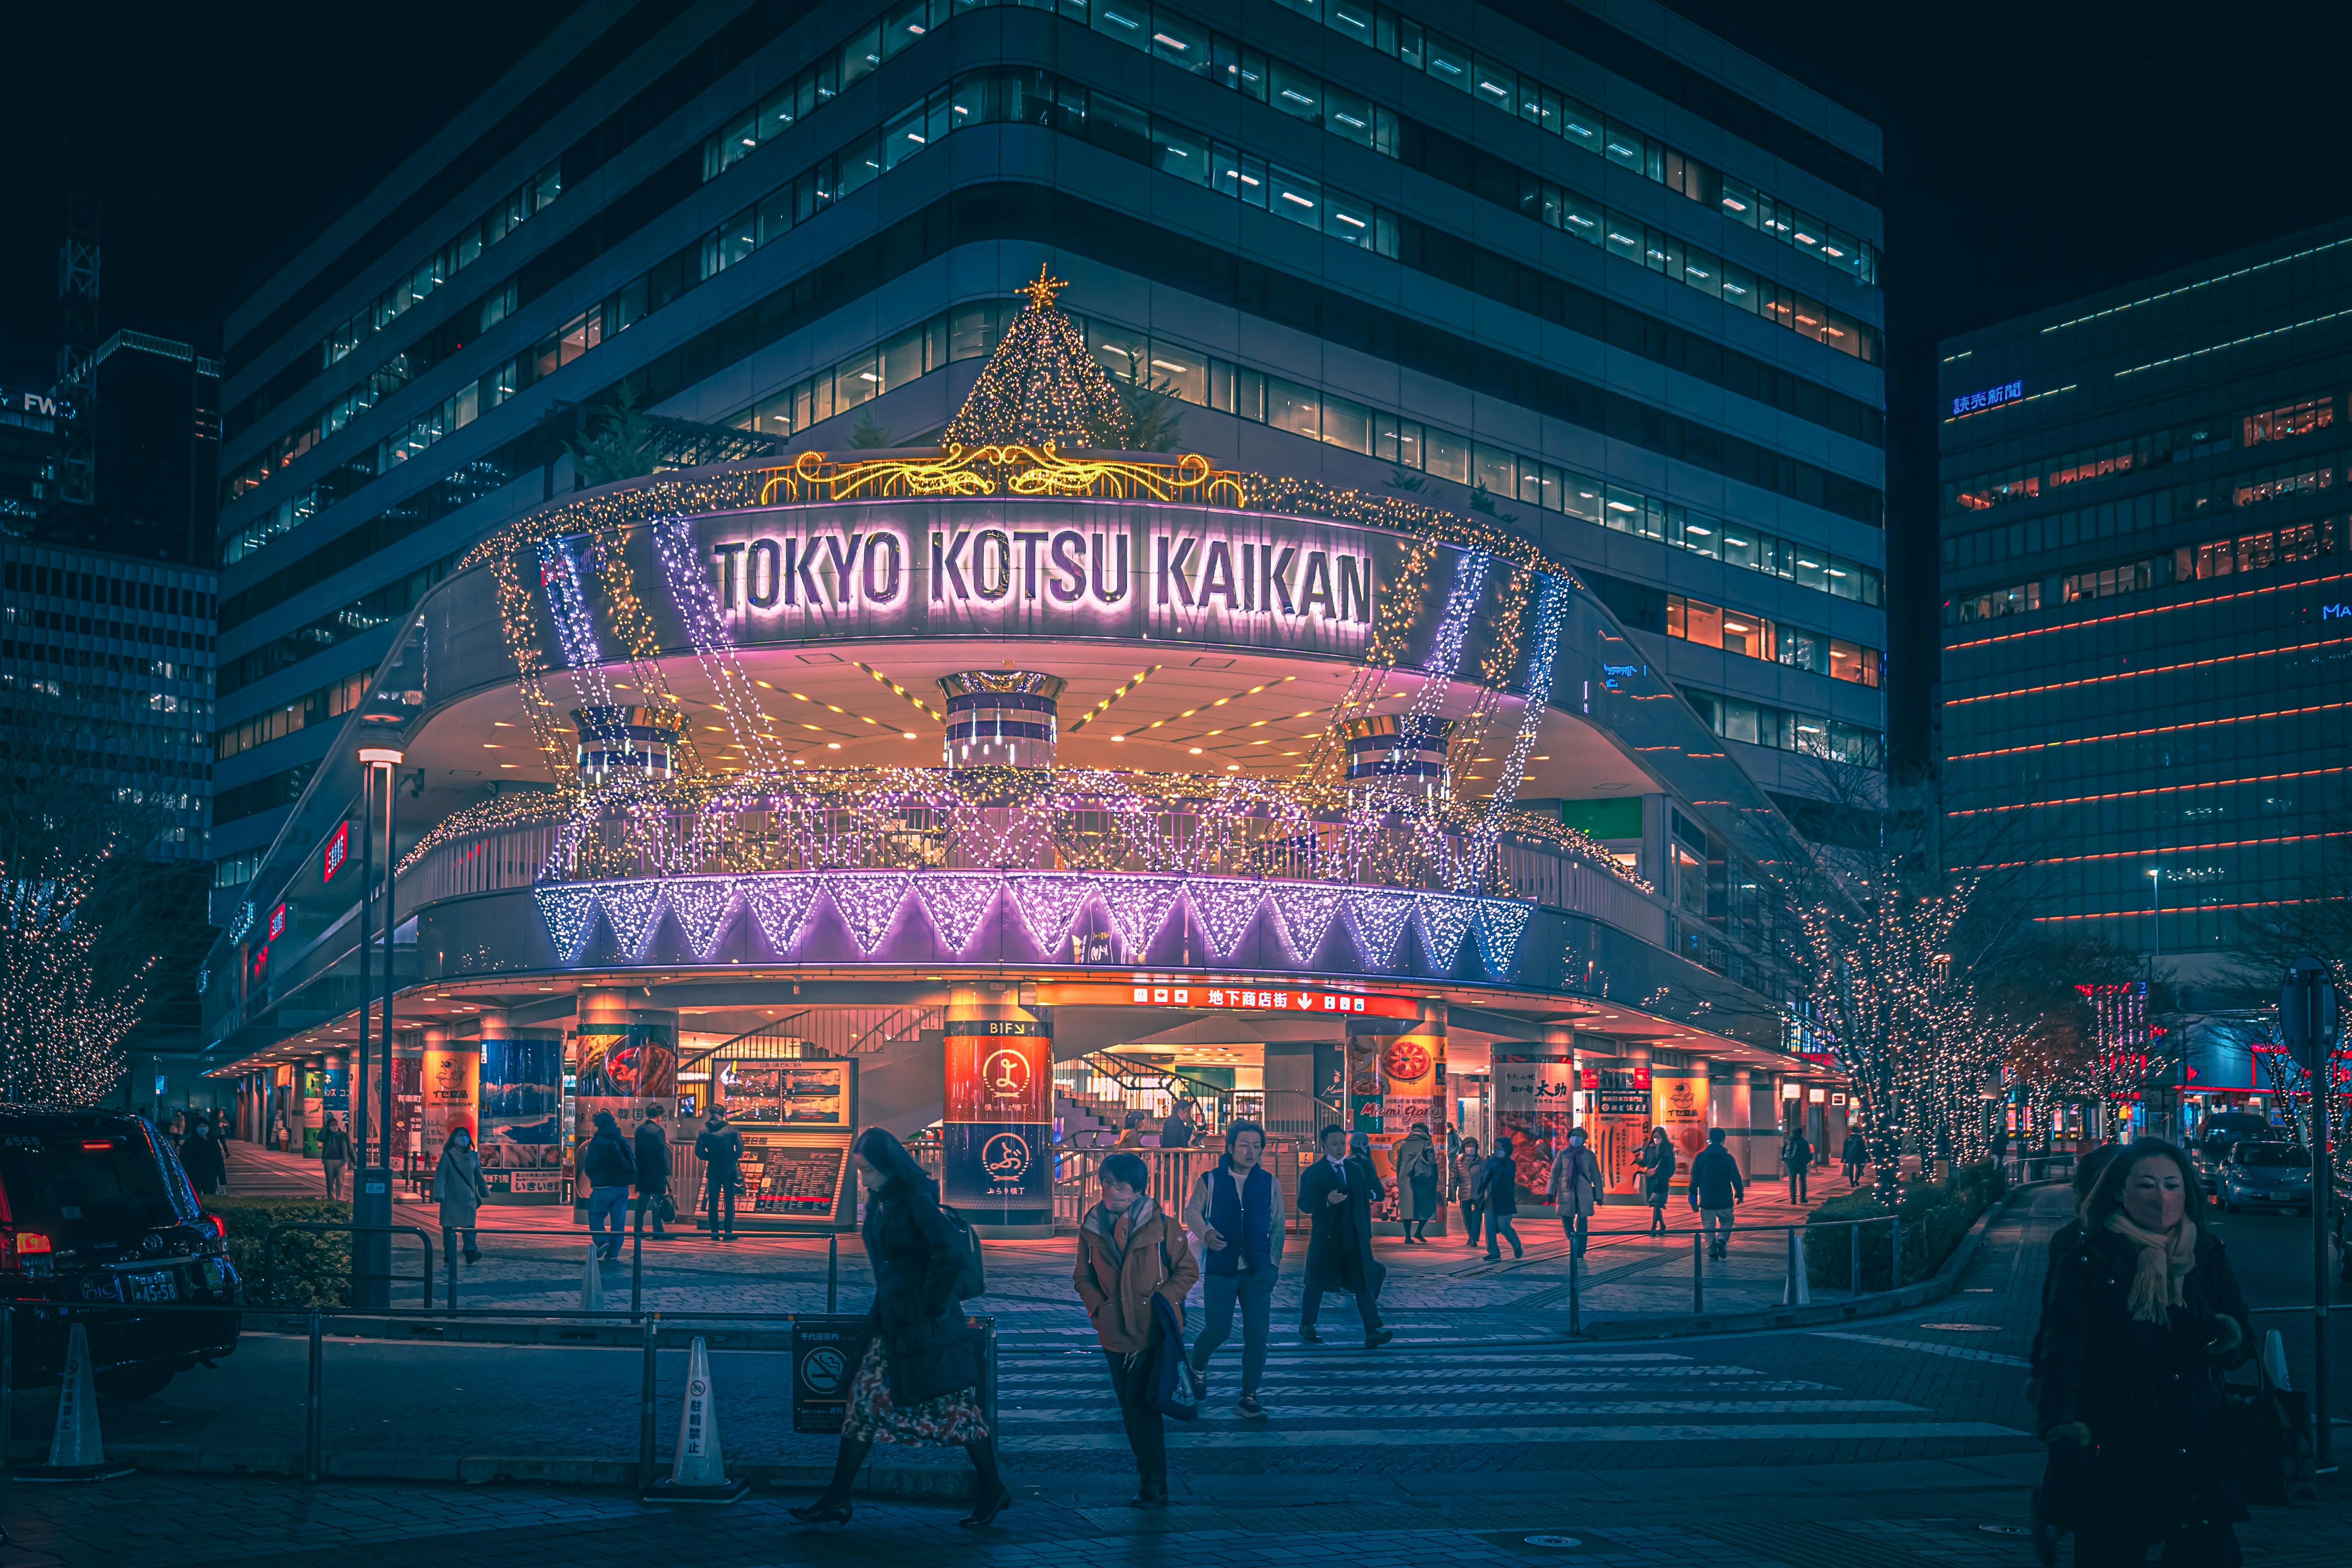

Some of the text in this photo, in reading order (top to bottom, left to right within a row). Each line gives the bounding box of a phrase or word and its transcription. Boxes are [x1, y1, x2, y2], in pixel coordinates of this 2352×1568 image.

[1953, 381, 2021, 414] 読売新聞
[715, 530, 1371, 624] TOKYO KOTSU KAIKAN
[1208, 989, 1287, 1008] 地下商店街
[990, 1023, 1013, 1034] B1F
[1534, 1080, 1567, 1097] 太助
[1360, 1102, 1403, 1117] Miami
[688, 1400, 702, 1453] 駐輪禁止
